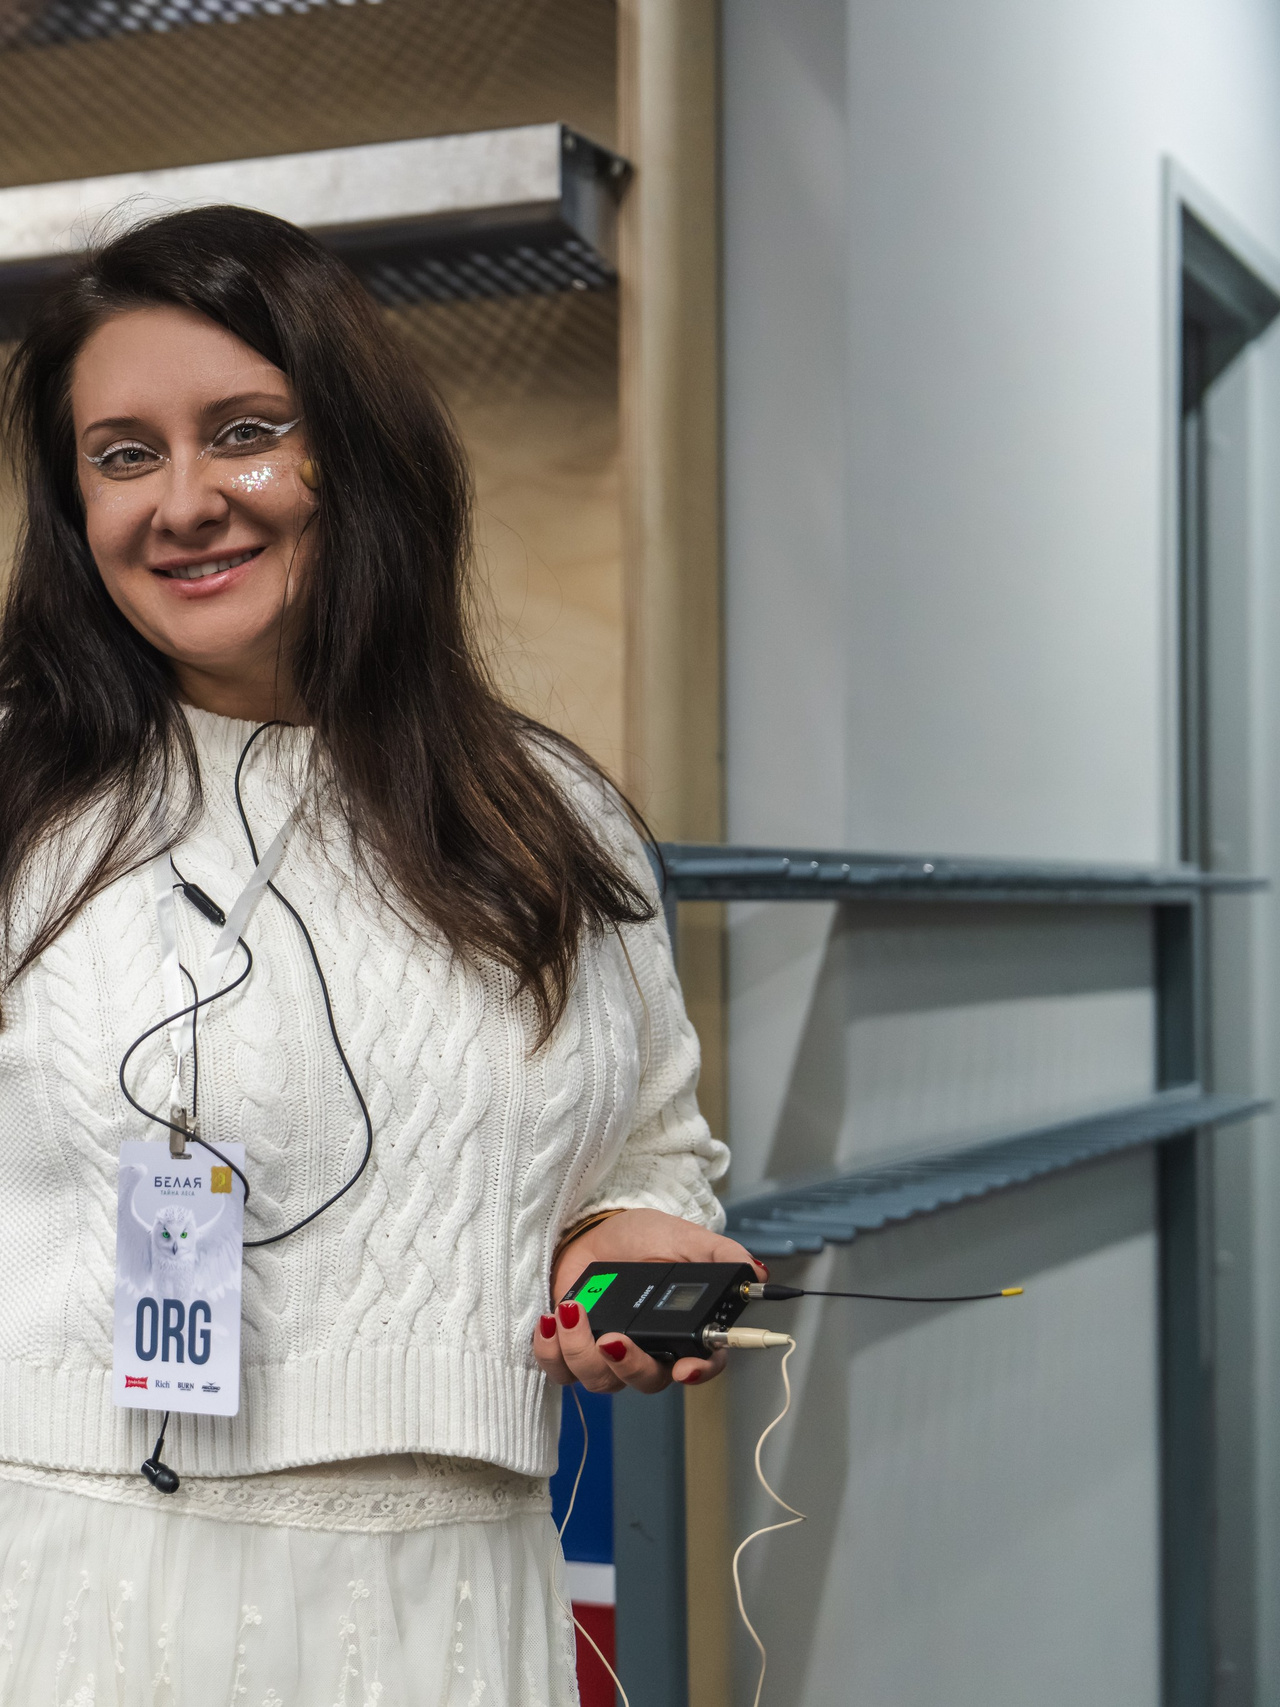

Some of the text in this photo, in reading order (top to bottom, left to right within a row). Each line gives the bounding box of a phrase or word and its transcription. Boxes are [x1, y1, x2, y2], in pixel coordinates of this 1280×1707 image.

[154, 1176, 202, 1189] БЕЛАЯ
[633, 1284, 654, 1309] SHURE
[135, 1297, 212, 1366] ORG
[155, 1379, 170, 1388] Rich
[177, 1381, 195, 1389] BURN
